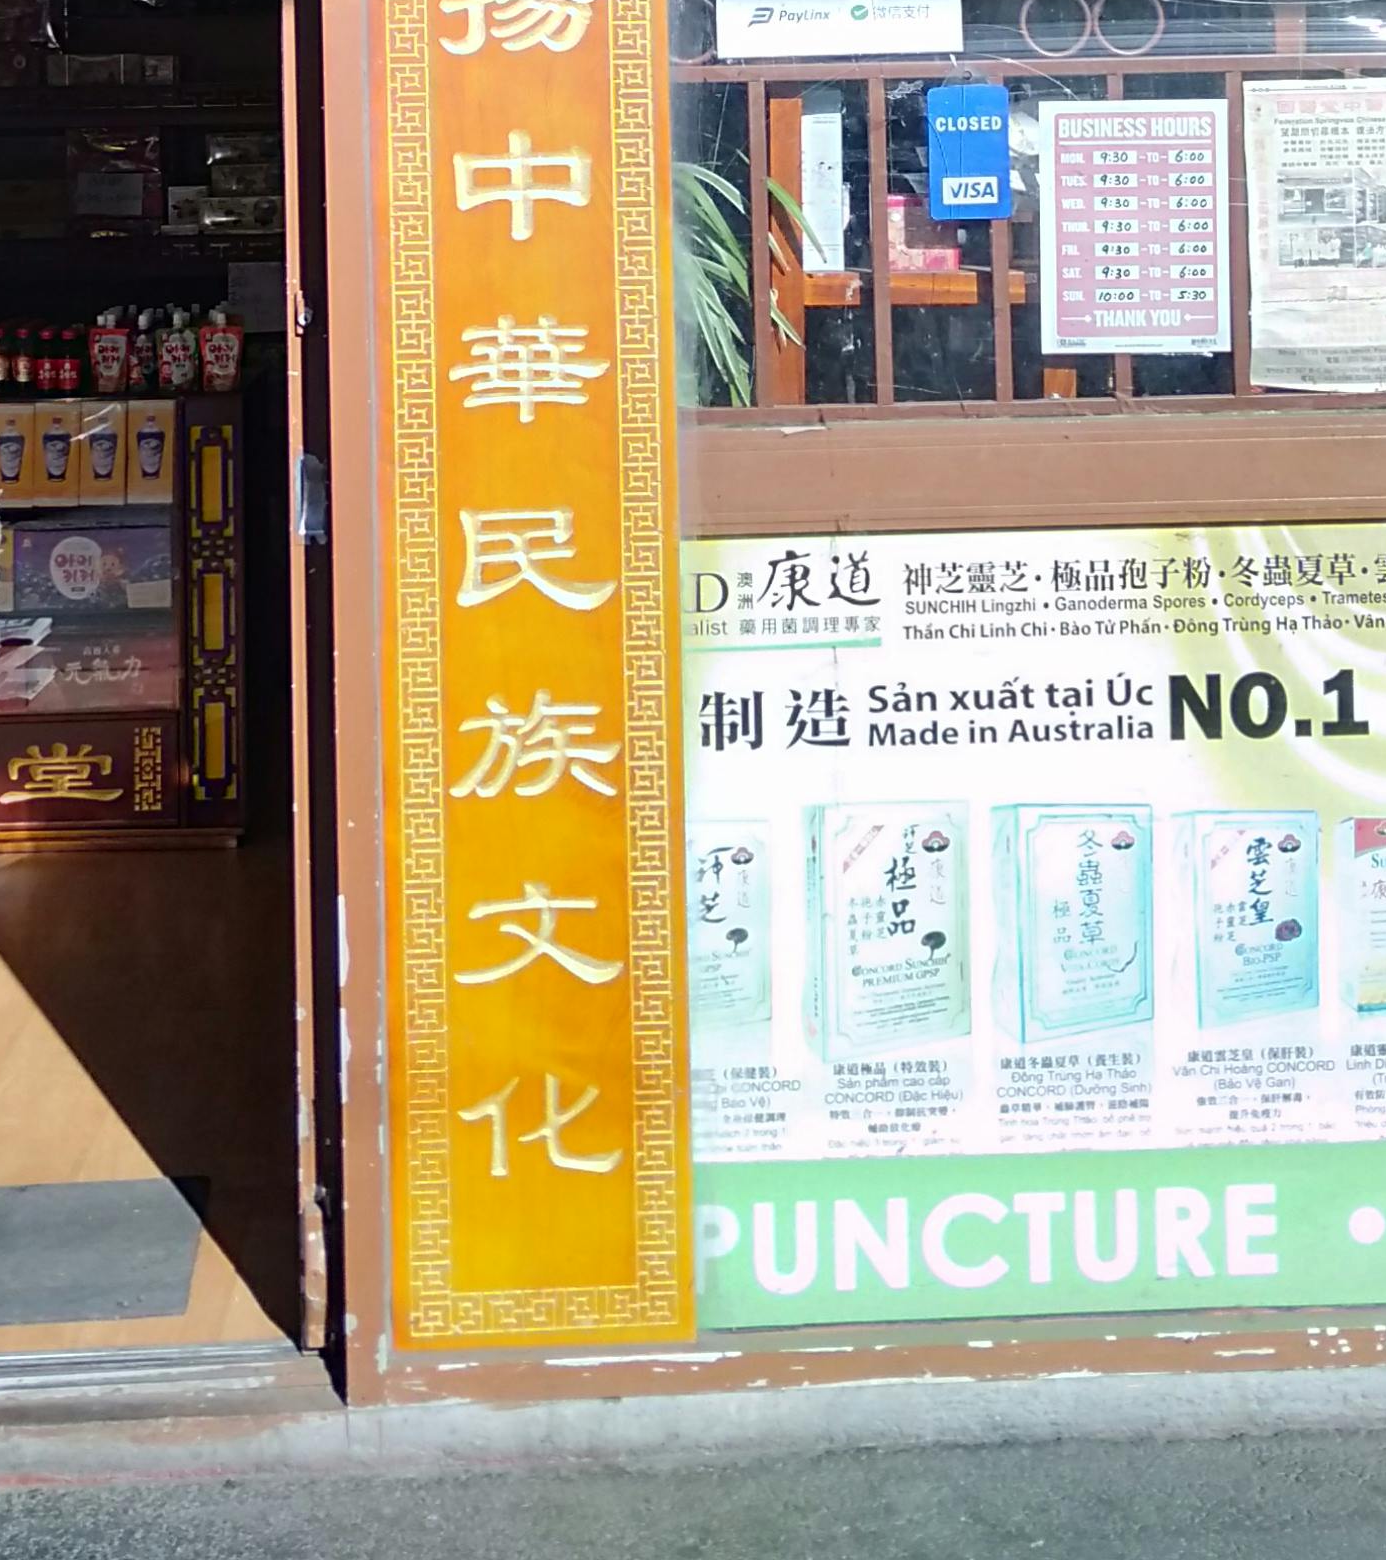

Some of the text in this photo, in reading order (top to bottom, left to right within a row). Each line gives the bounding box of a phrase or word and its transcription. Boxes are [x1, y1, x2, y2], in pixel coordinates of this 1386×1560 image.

[779, 9, 830, 24] PayLinx
[934, 114, 1003, 133] CLOSED
[1058, 116, 1212, 139] BUSINESS HOURS
[1100, 151, 1129, 163] 9:30
[1174, 150, 1205, 162] 6:00
[1100, 174, 1129, 186] 9:30
[1174, 173, 1205, 186] 6:00
[949, 180, 996, 201] VISA
[1100, 196, 1130, 209] 9:30
[1176, 196, 1208, 208] 6:00
[1102, 220, 1132, 232] 9:30
[1178, 219, 1209, 232] 6:00
[1102, 243, 1131, 255] 9:30
[1178, 242, 1208, 254] 6:00
[1101, 266, 1131, 279] 9:30
[1179, 266, 1207, 279] 6:00
[1098, 291, 1135, 302] 10:00
[1177, 290, 1207, 301] 5:30
[1093, 309, 1182, 328] THANK YOU
[757, 549, 882, 612] 康道
[904, 600, 977, 615] SUNCHIH
[981, 598, 1037, 616] Lingzhi
[1054, 594, 1149, 612] Ganoderma
[1153, 594, 1206, 611] Spores
[1223, 592, 1305, 610] Cordyceps
[949, 623, 976, 639] Chi
[980, 622, 1017, 638] Linh
[1021, 621, 1048, 637] Chi
[1173, 617, 1219, 637] Đông
[1223, 616, 1272, 636] Trùng
[1354, 613, 1386, 629] Vân
[868, 673, 1154, 717] Sản xuất tại Úc
[1168, 668, 1370, 741] NO.1
[868, 715, 1154, 747] Made in Australia
